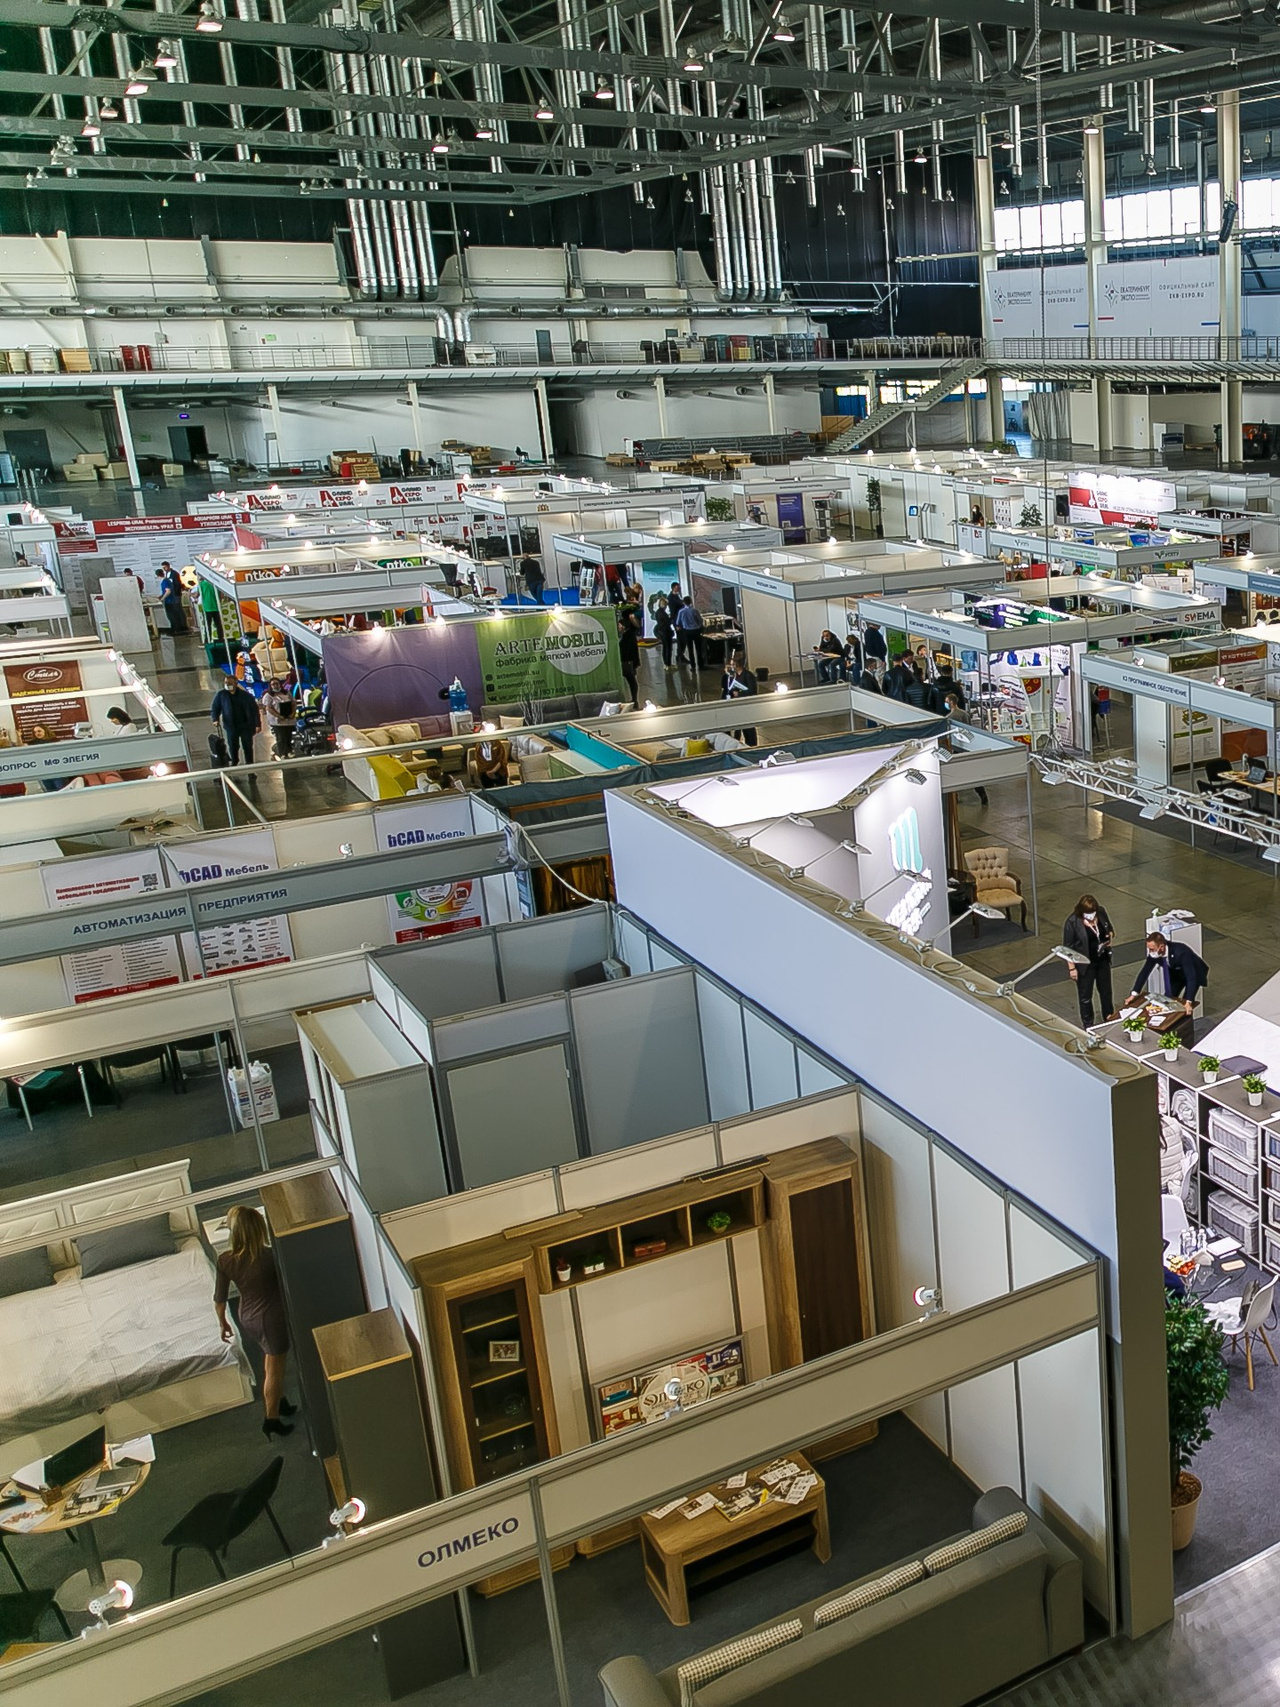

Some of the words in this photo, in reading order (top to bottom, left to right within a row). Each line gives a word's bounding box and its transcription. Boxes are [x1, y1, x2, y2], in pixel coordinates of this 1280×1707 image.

[496, 656, 538, 668] фабрика
[540, 650, 571, 662] мягкой
[573, 648, 606, 658] мебели
[44, 758, 60, 766] МФ
[63, 754, 100, 764] ЭЛЕГИЯ
[426, 830, 466, 842] Мебель
[225, 862, 269, 877] Мебель
[73, 906, 187, 935] АВТОМАТИЗАЦИЯ
[198, 888, 288, 912] ПРЕДПРИЯТИЯ
[417, 1517, 520, 1569] ОЛМЕКО
